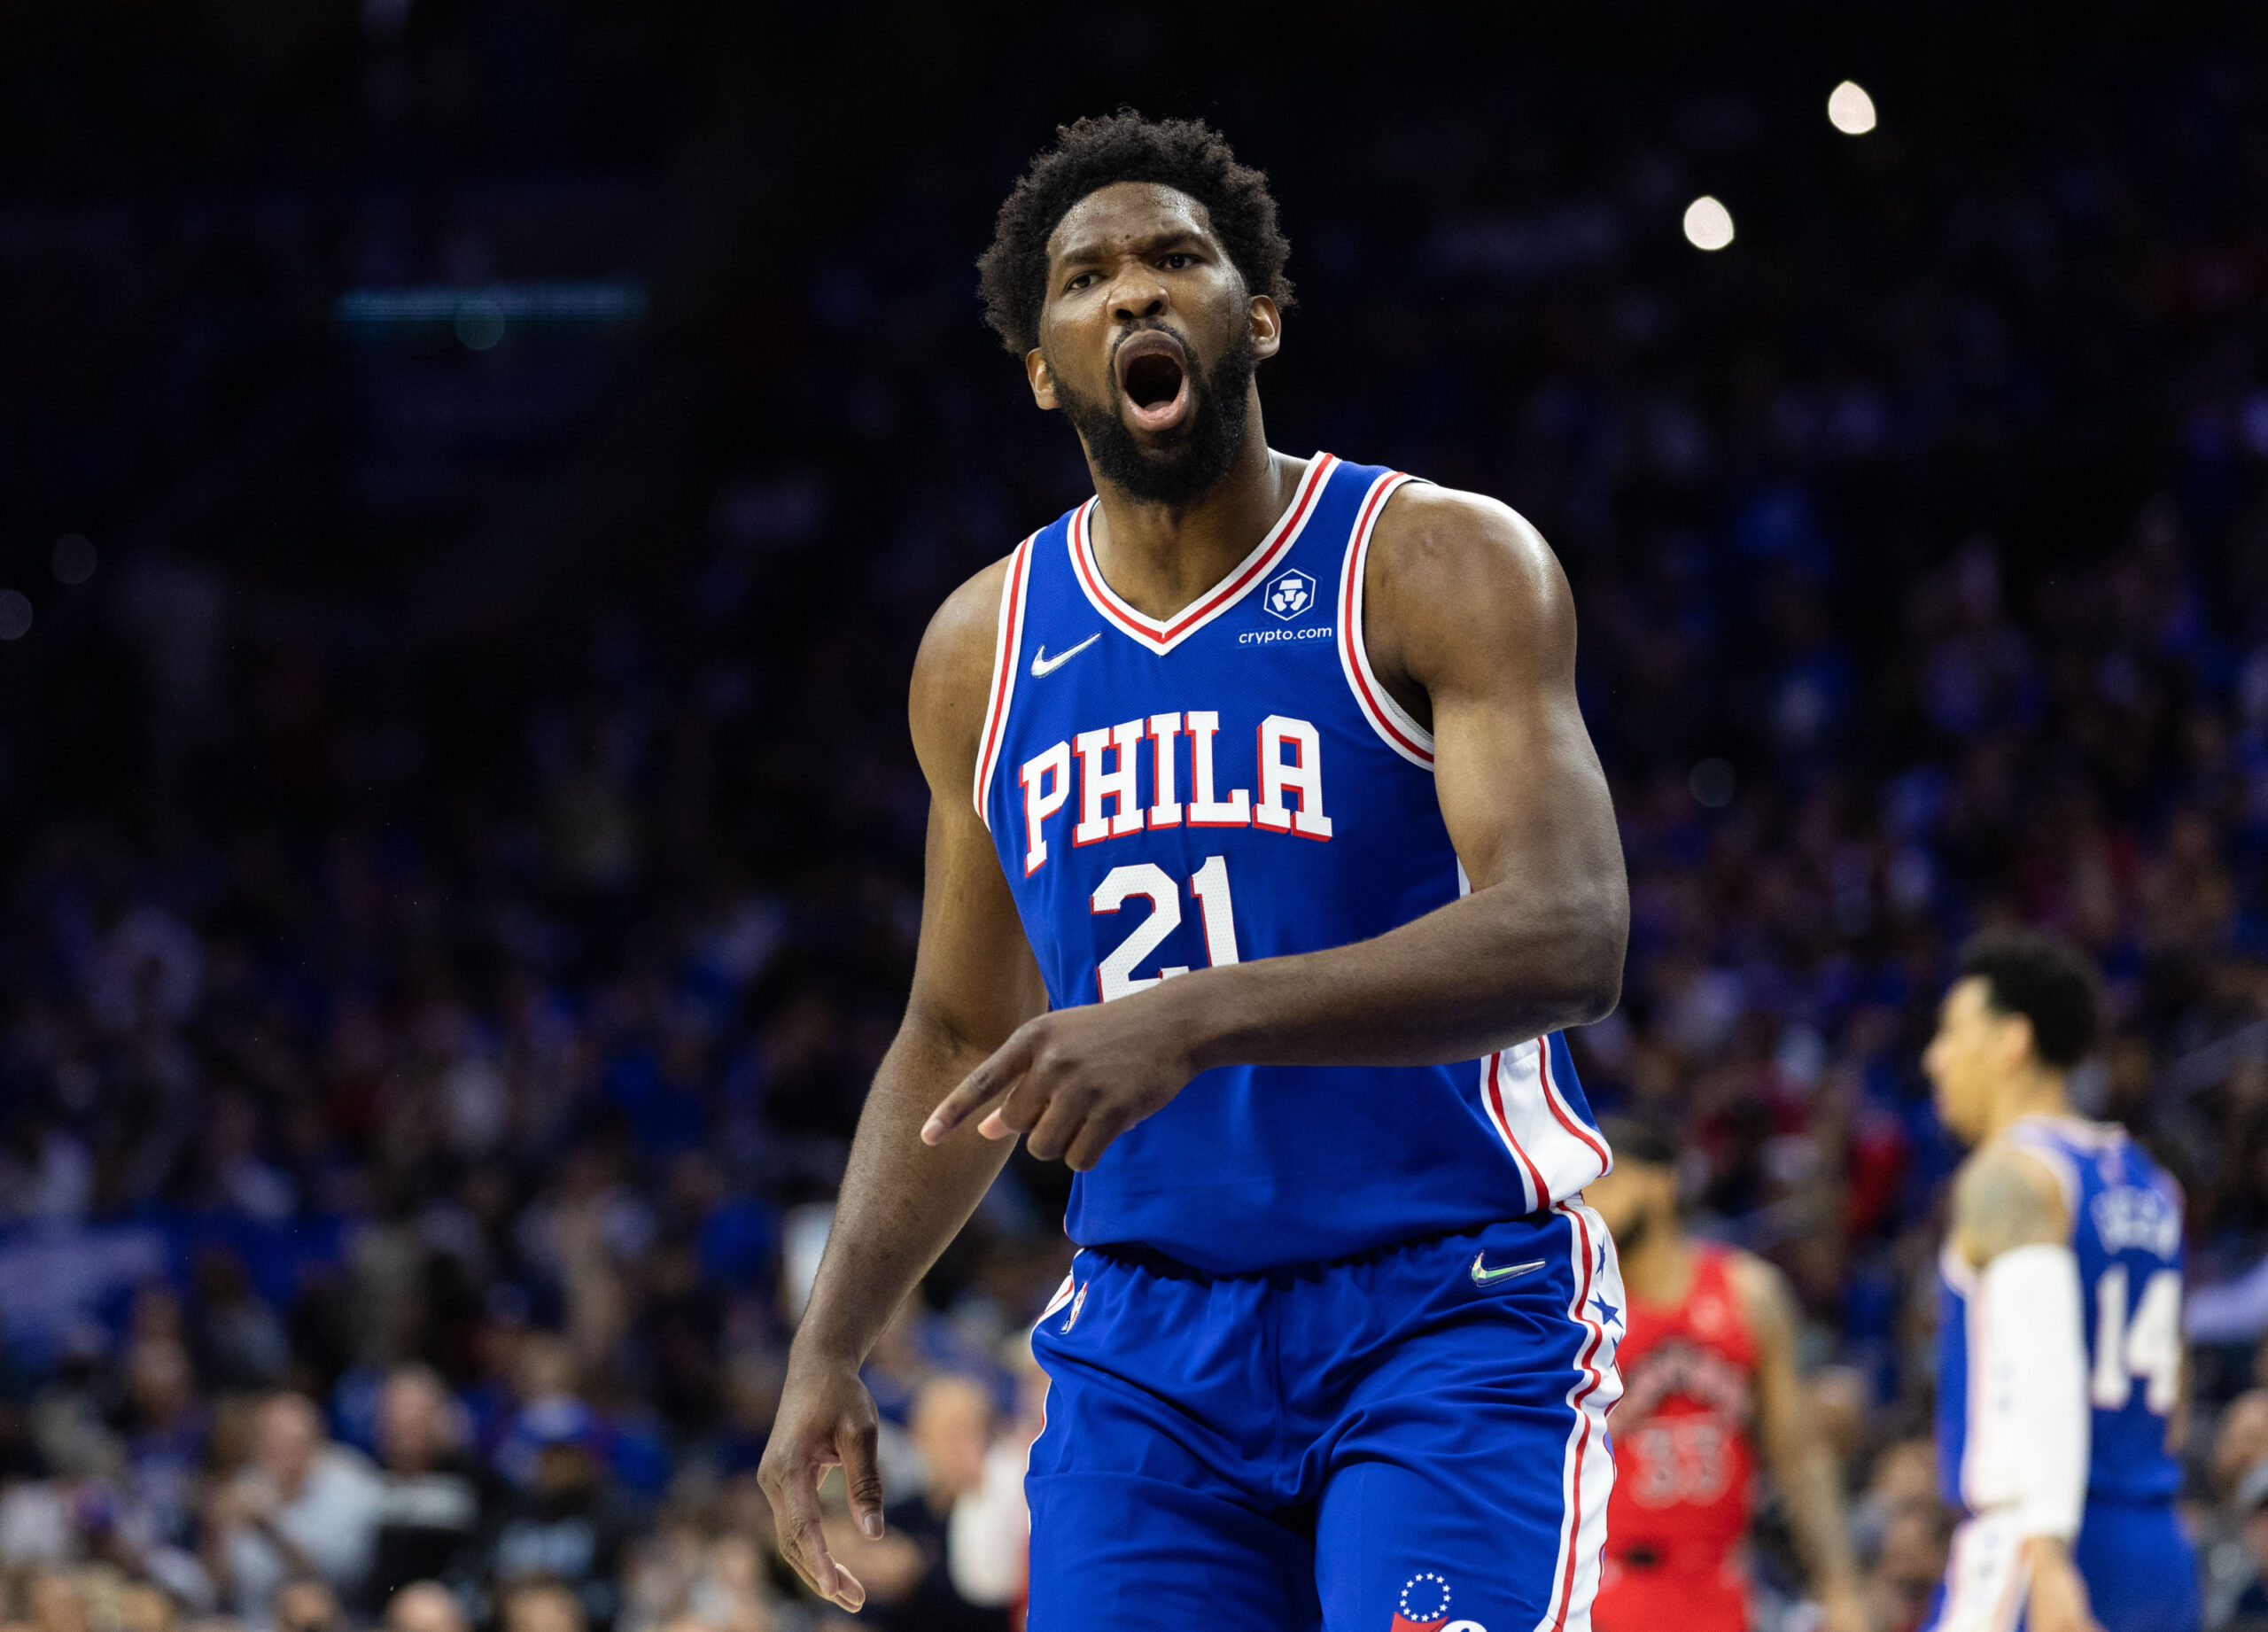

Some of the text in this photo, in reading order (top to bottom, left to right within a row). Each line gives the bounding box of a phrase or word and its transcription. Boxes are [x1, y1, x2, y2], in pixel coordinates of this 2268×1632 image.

[1239, 627, 1332, 644] crypto.com
[1020, 711, 1332, 878] PHILA
[1090, 855, 1239, 1004] 21
[2092, 1263, 2182, 1414] 14
